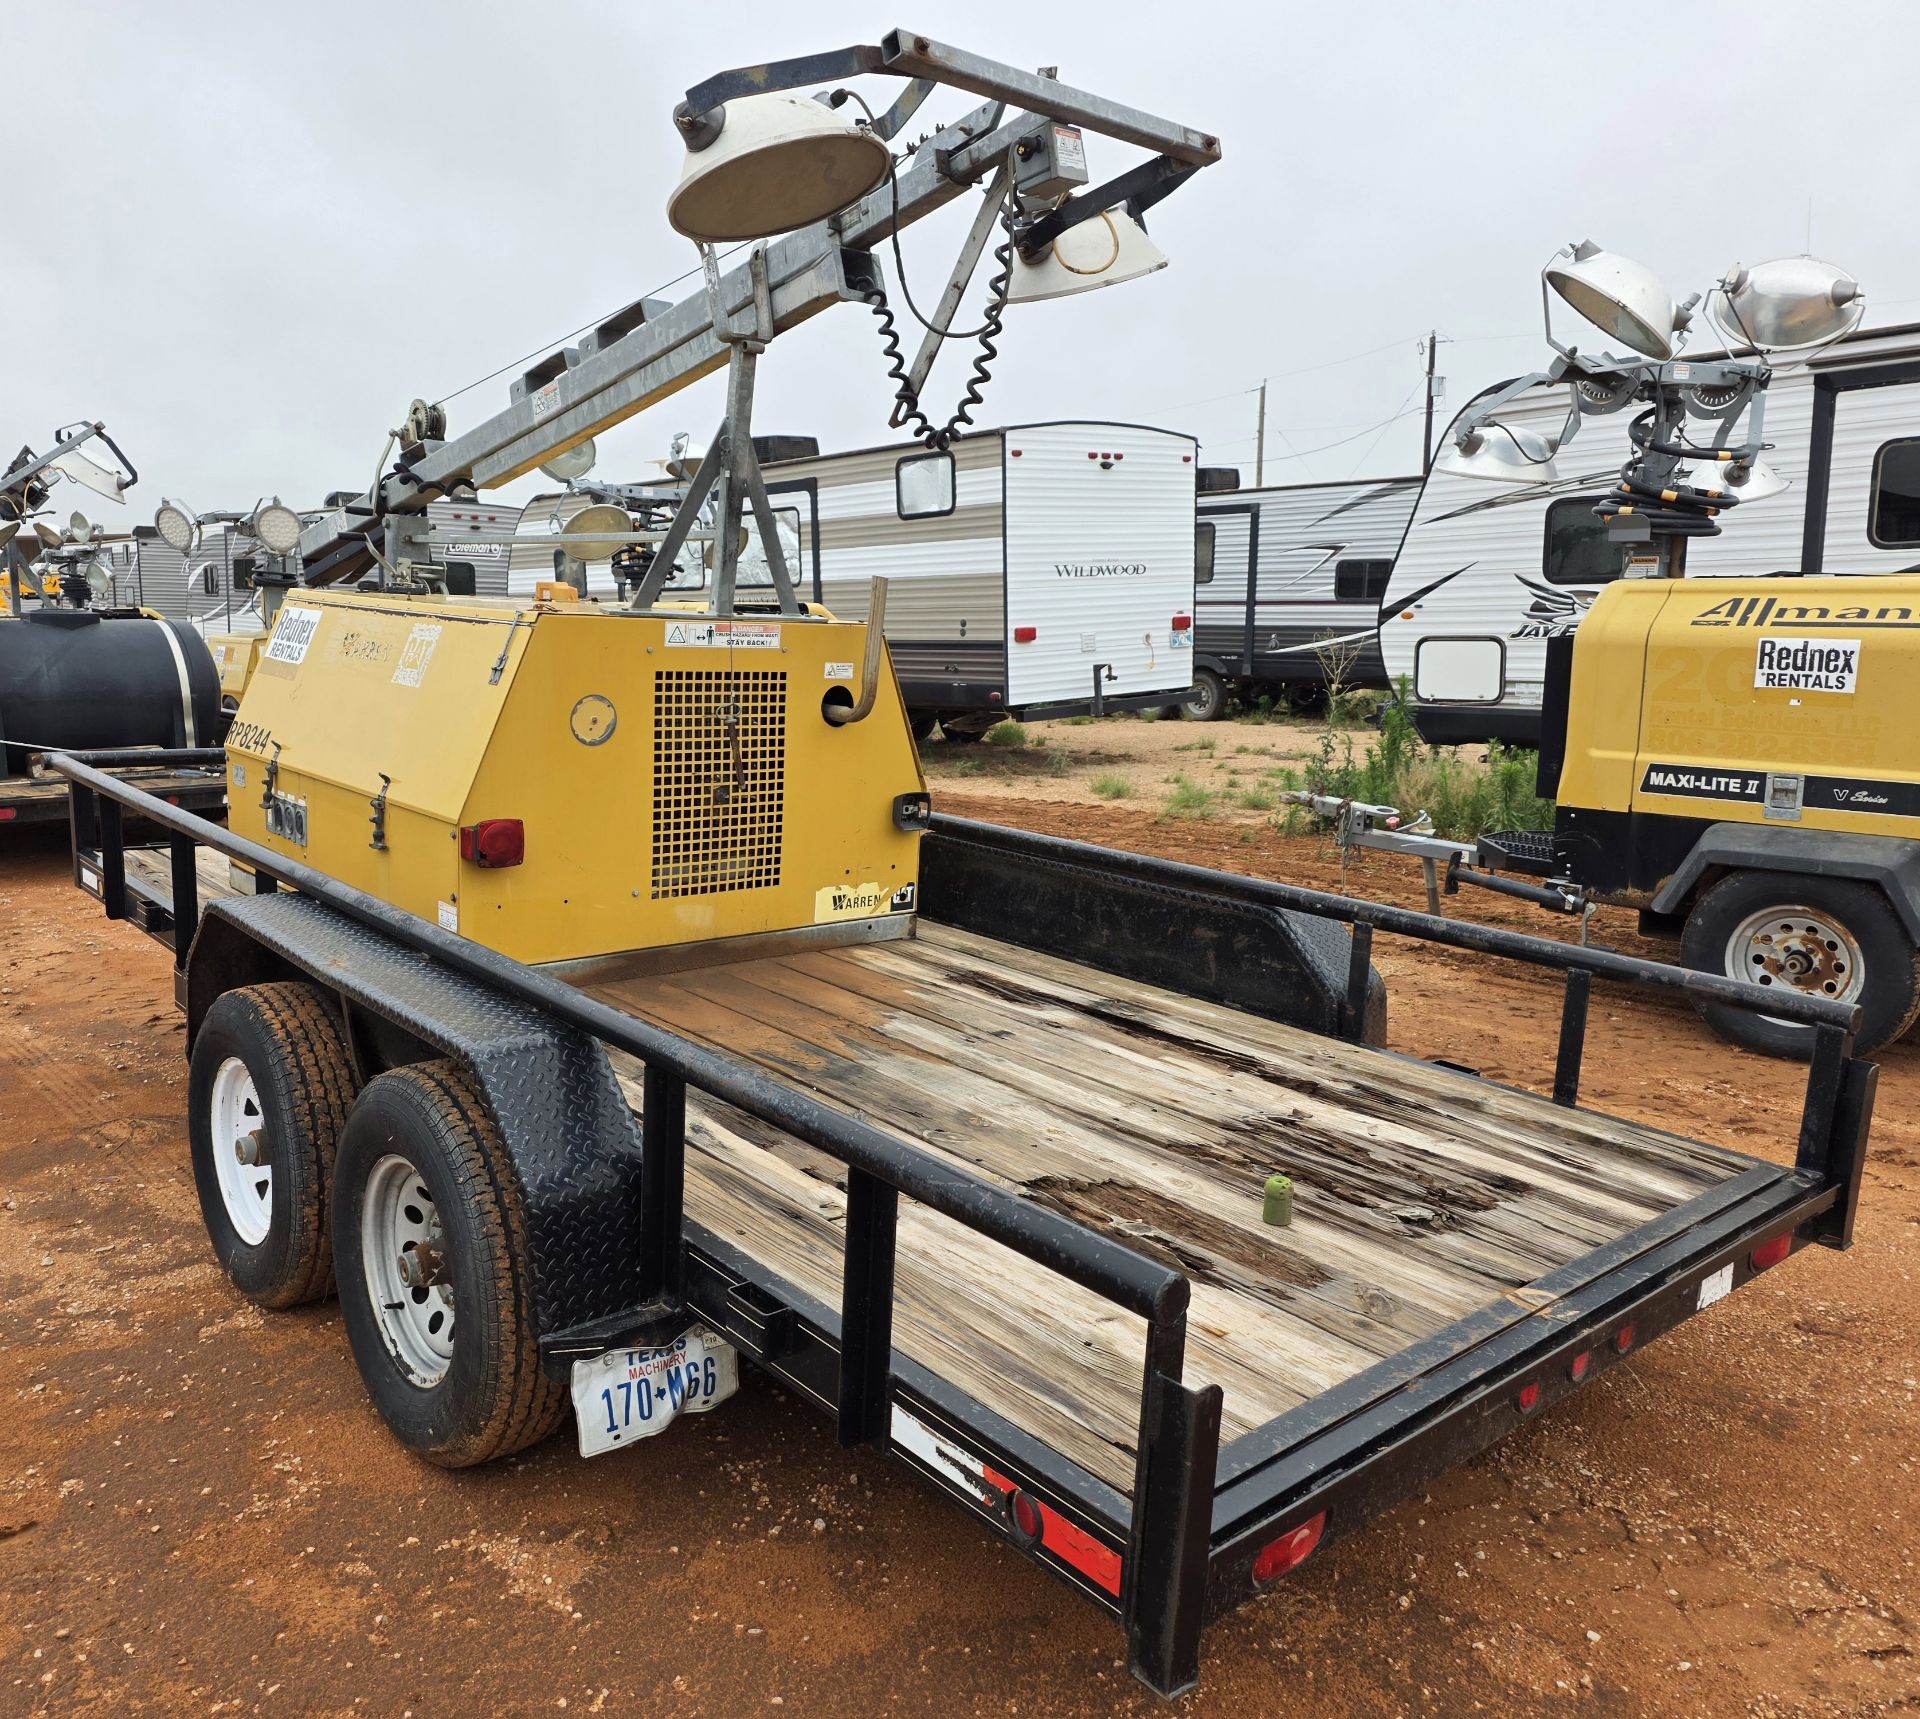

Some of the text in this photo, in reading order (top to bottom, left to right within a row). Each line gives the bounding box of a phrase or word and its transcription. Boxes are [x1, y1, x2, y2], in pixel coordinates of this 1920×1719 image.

[1054, 564, 1147, 577] WILDWOOD
[1696, 598, 1920, 626] Allman
[273, 609, 317, 645] Rednex
[269, 642, 303, 661] RENTALS
[1759, 640, 1855, 674] Rednex
[1765, 673, 1846, 689] RENTALS
[226, 721, 271, 754] RP8244
[1650, 772, 1759, 794] MAXI-LITE II
[1833, 789, 1889, 804] V Series
[832, 894, 881, 911] WARREN
[628, 1352, 687, 1381] MACHINERY
[601, 1377, 654, 1434] 170
